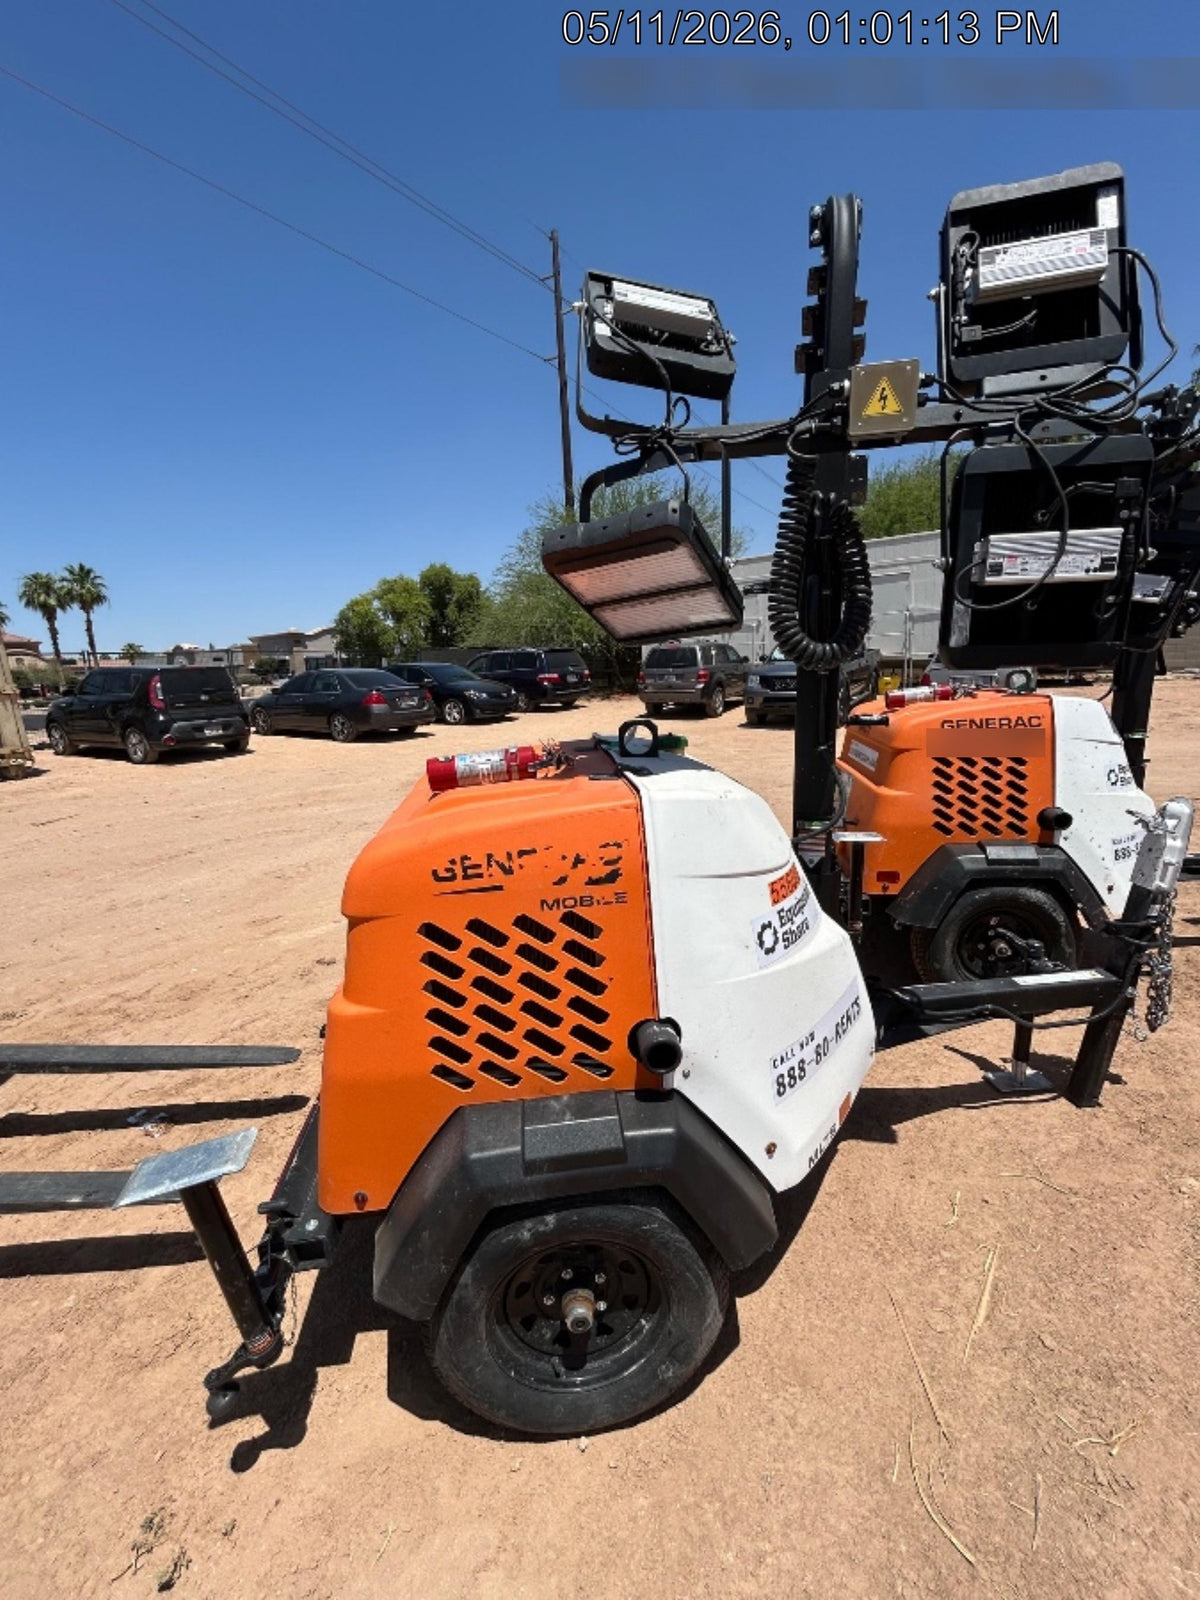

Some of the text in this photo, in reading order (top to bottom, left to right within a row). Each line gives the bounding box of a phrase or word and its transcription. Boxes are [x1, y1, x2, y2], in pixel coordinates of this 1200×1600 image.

[940, 715, 1044, 729] GENERAC
[775, 995, 862, 1097] 888-80-RENTS
[773, 1048, 796, 1069] CALL
